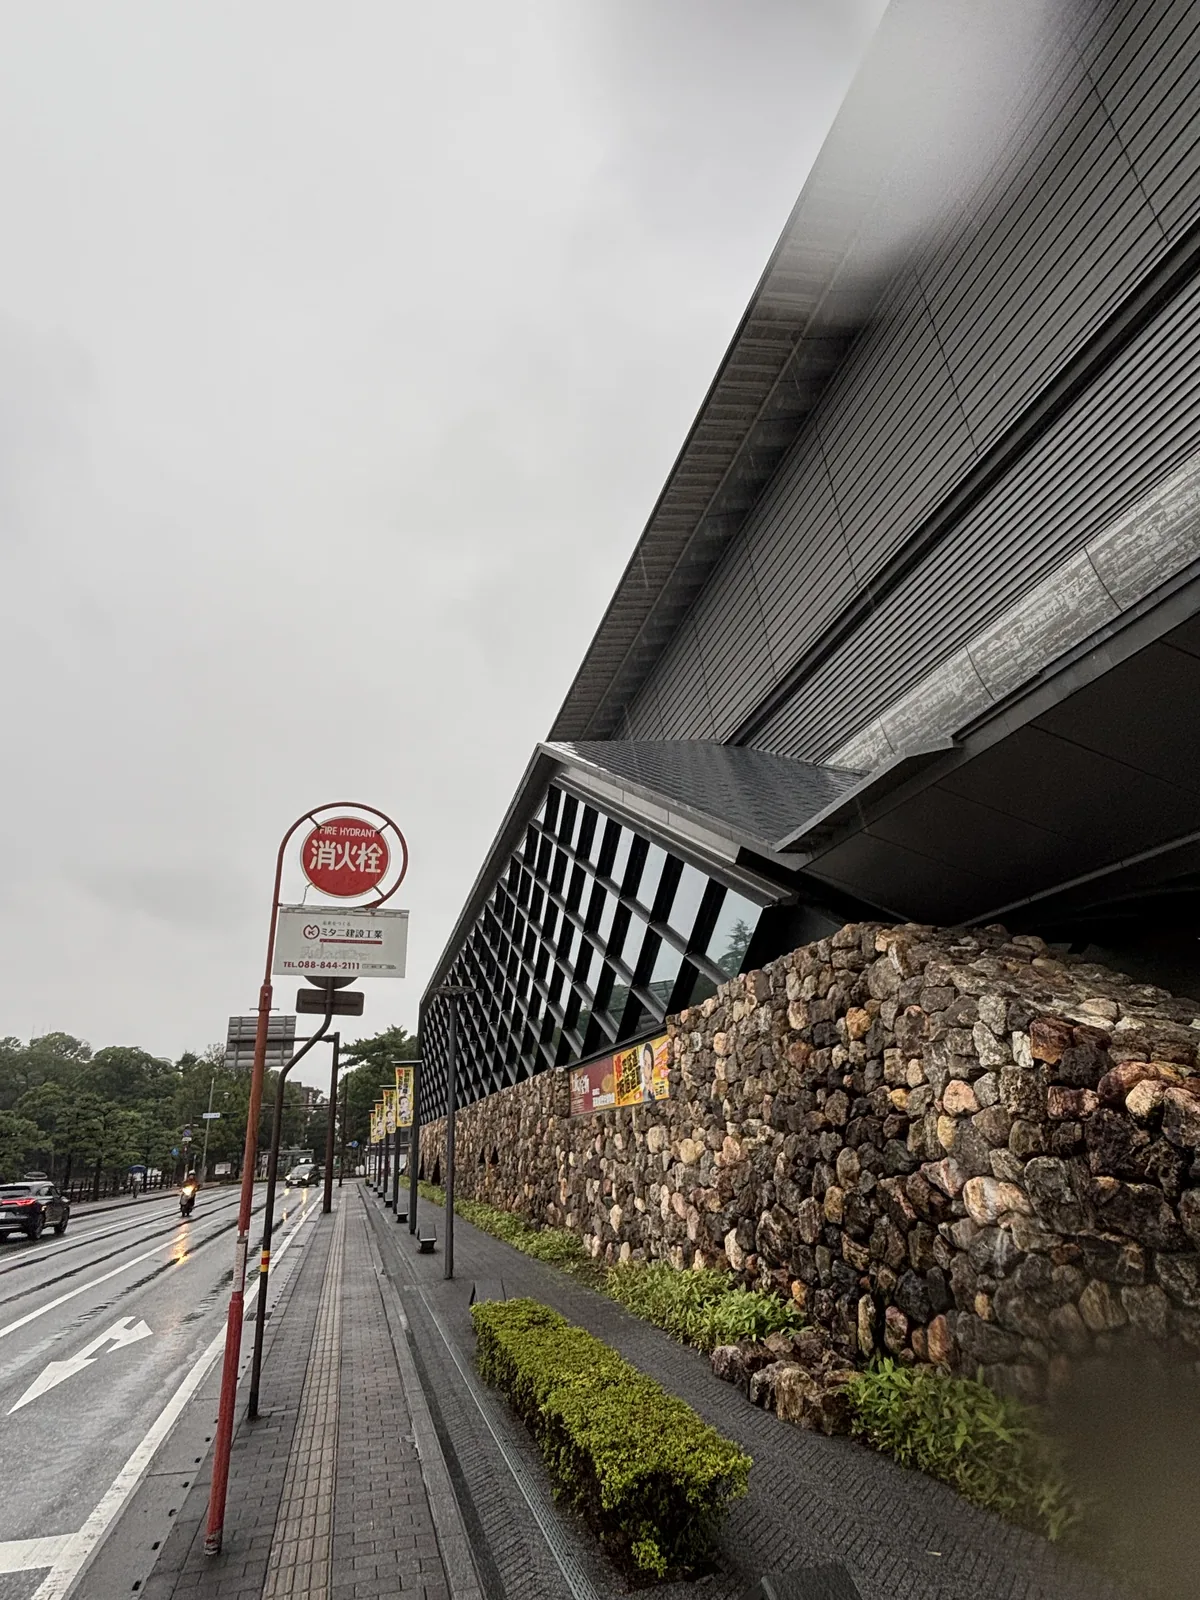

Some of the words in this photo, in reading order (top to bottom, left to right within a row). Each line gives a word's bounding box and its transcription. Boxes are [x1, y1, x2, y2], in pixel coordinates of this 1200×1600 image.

[319, 825, 338, 835] FIRE
[339, 827, 377, 838] HYDRANT
[309, 839, 384, 873] 消火栓
[320, 927, 383, 939] ミタニ建設工業
[283, 960, 360, 970] TEL.088-844-2111
